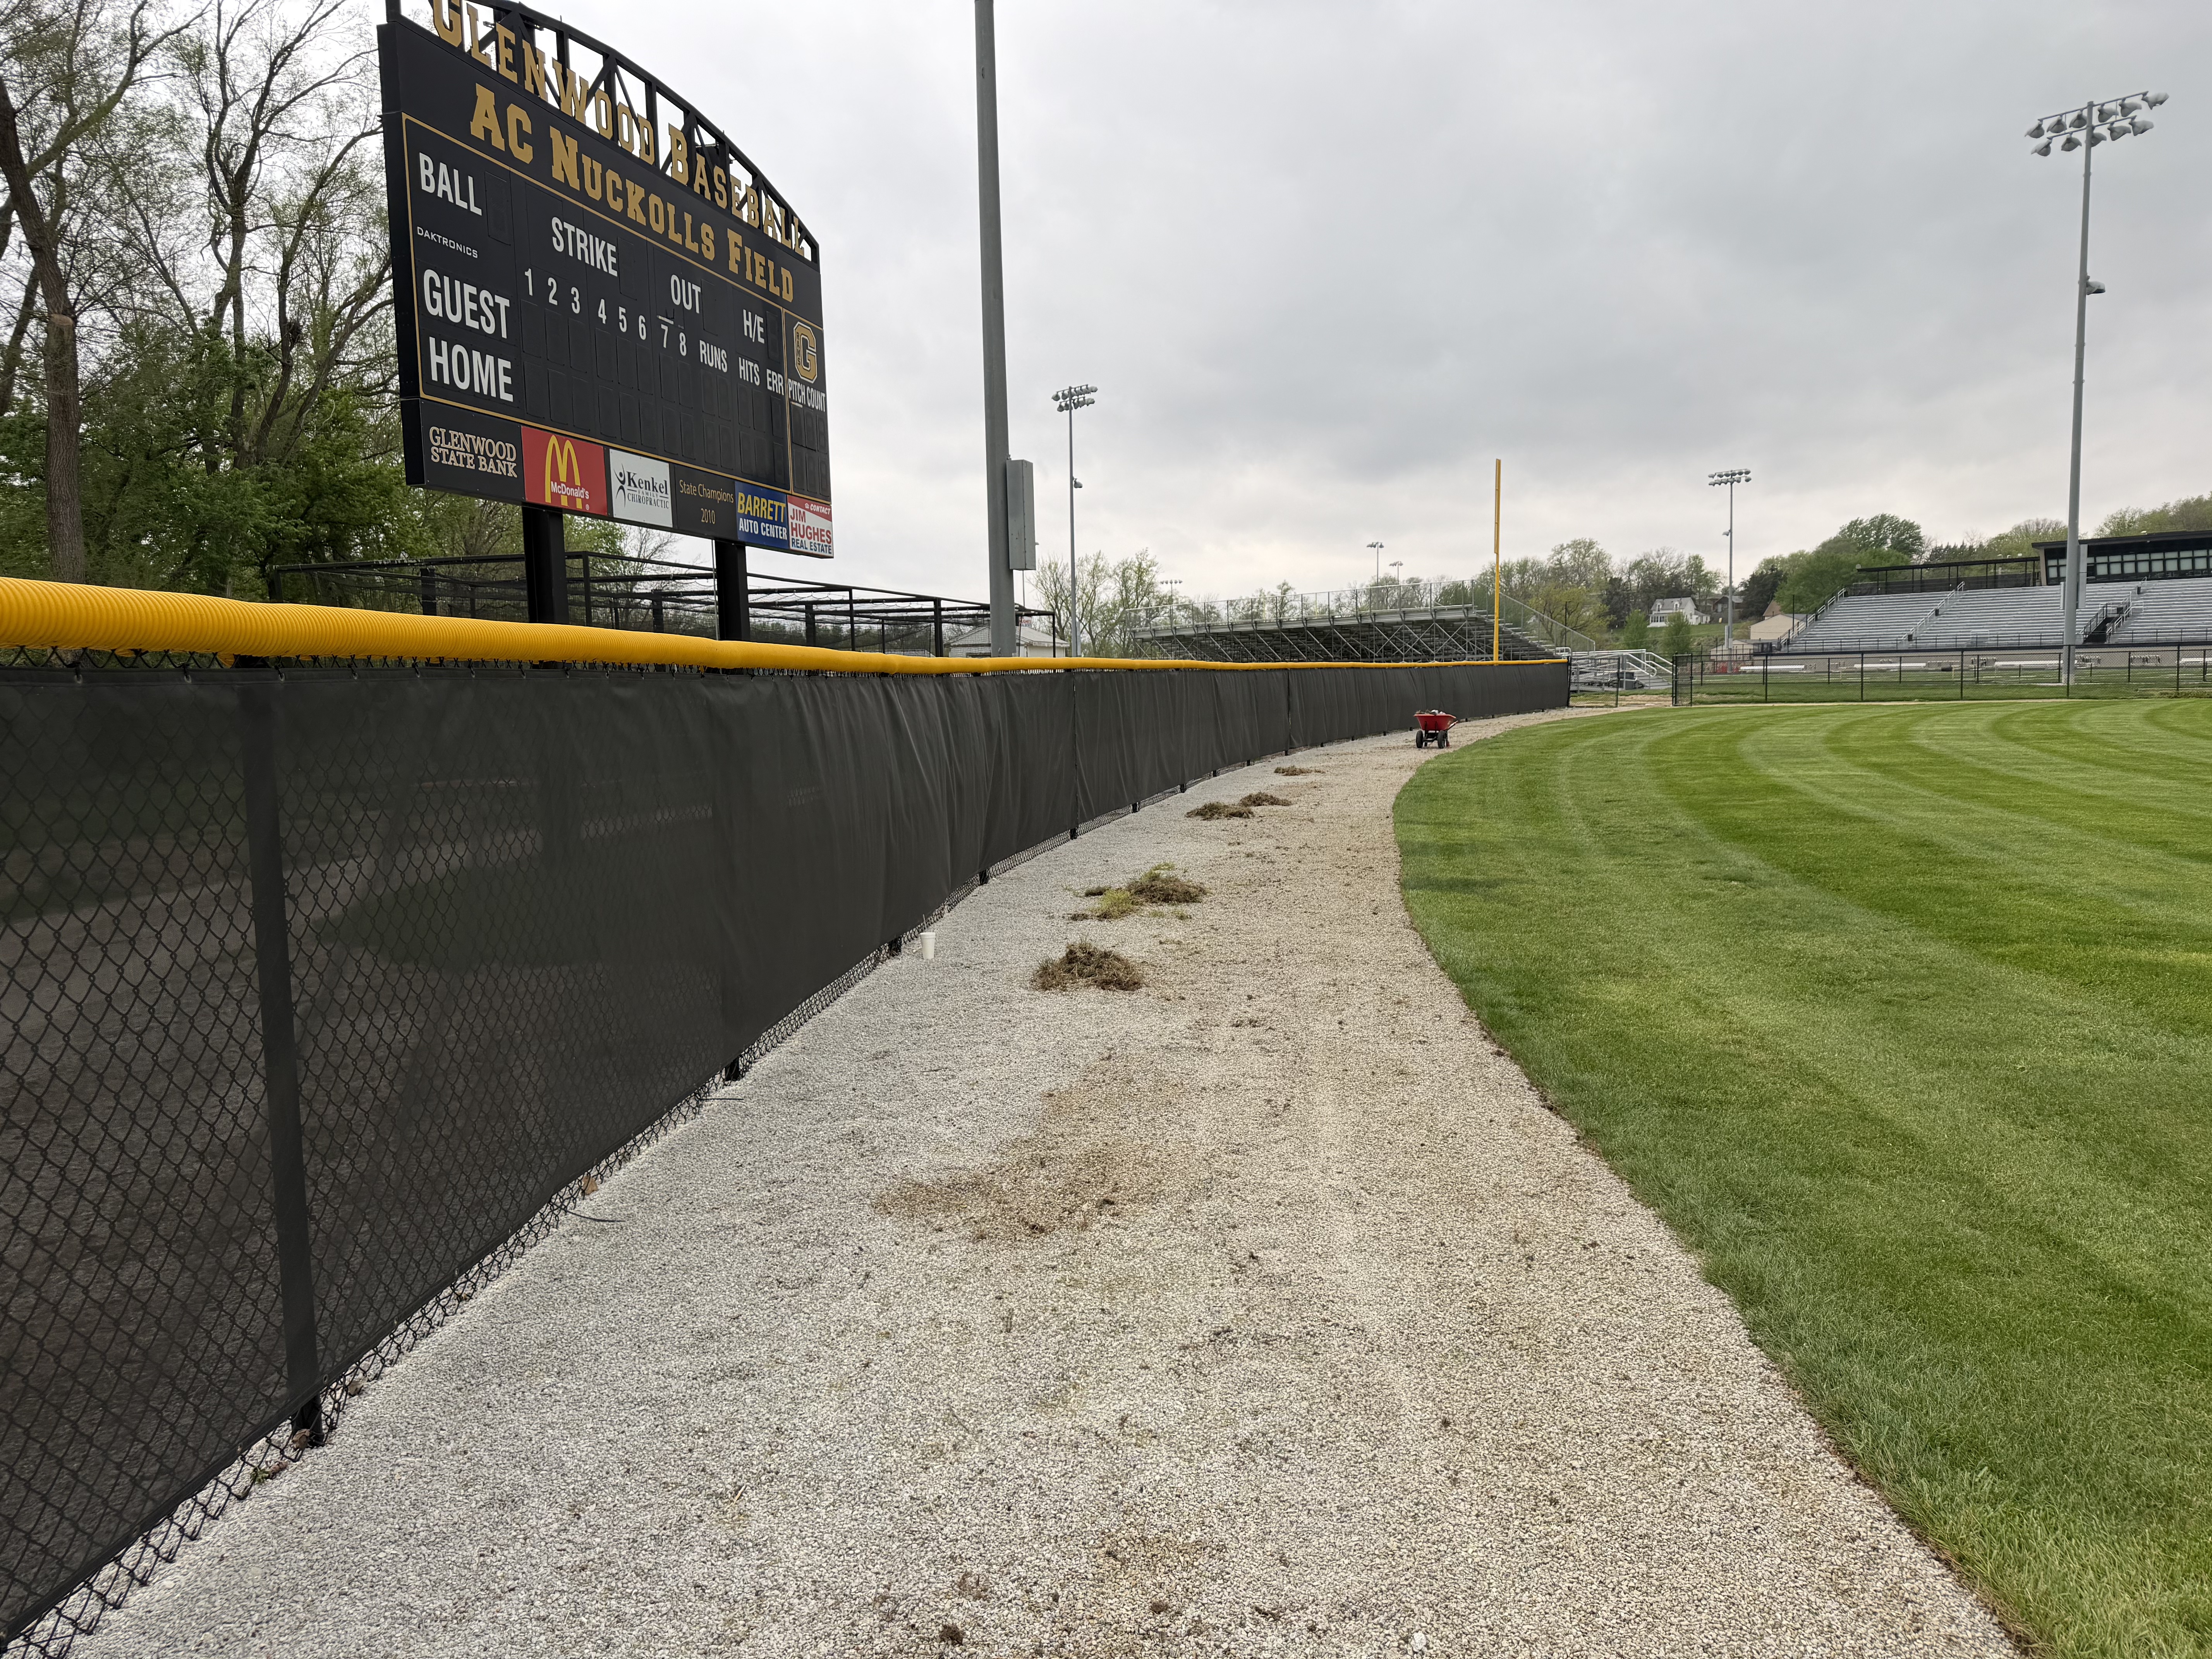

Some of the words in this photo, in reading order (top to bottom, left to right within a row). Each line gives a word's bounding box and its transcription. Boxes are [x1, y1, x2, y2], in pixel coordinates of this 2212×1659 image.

[433, 0, 654, 165] GLENWOOD
[668, 123, 804, 257] BASEBALL
[419, 153, 482, 216] BALL
[471, 83, 533, 163] AC
[550, 126, 714, 260] NUCKOLLS
[728, 228, 793, 302] FIELD
[417, 226, 477, 258] DAKTRONICS
[552, 217, 618, 276] STRIKE
[424, 270, 510, 338] GUEST
[671, 275, 701, 313] OUT
[525, 268, 532, 296] 1
[548, 278, 558, 305] 2
[571, 287, 580, 314] 3
[598, 299, 606, 324] 4
[619, 306, 627, 332] 5
[639, 315, 646, 340] 6
[661, 324, 668, 348] 7
[680, 332, 687, 356] 8
[700, 340, 727, 373] RUNS
[738, 357, 760, 386] HITS
[766, 369, 784, 395] ERR
[743, 309, 764, 343] H/E
[793, 321, 817, 383] G
[429, 337, 513, 402] HOME
[788, 378, 805, 404] PITCH
[807, 386, 826, 412] COUNT
[429, 426, 517, 462] GLENWOOD
[431, 447, 475, 469] STATE
[477, 456, 517, 478] BANK
[551, 481, 589, 499] McDonald's
[626, 471, 668, 495] Kenkel
[638, 490, 658, 498] FAMILY
[680, 479, 697, 496] State
[698, 484, 733, 503] Champions
[628, 493, 669, 509] CHIROPRACTIC
[701, 508, 715, 524] 2010
[737, 492, 786, 522] BARRETT
[790, 508, 806, 522] JIM
[810, 503, 831, 515] CONTACT
[739, 518, 758, 534] AUTO
[761, 522, 787, 540] CENTER
[791, 522, 832, 544] HUGHES
[792, 538, 808, 550] REAL
[810, 542, 832, 554] ESTATE
